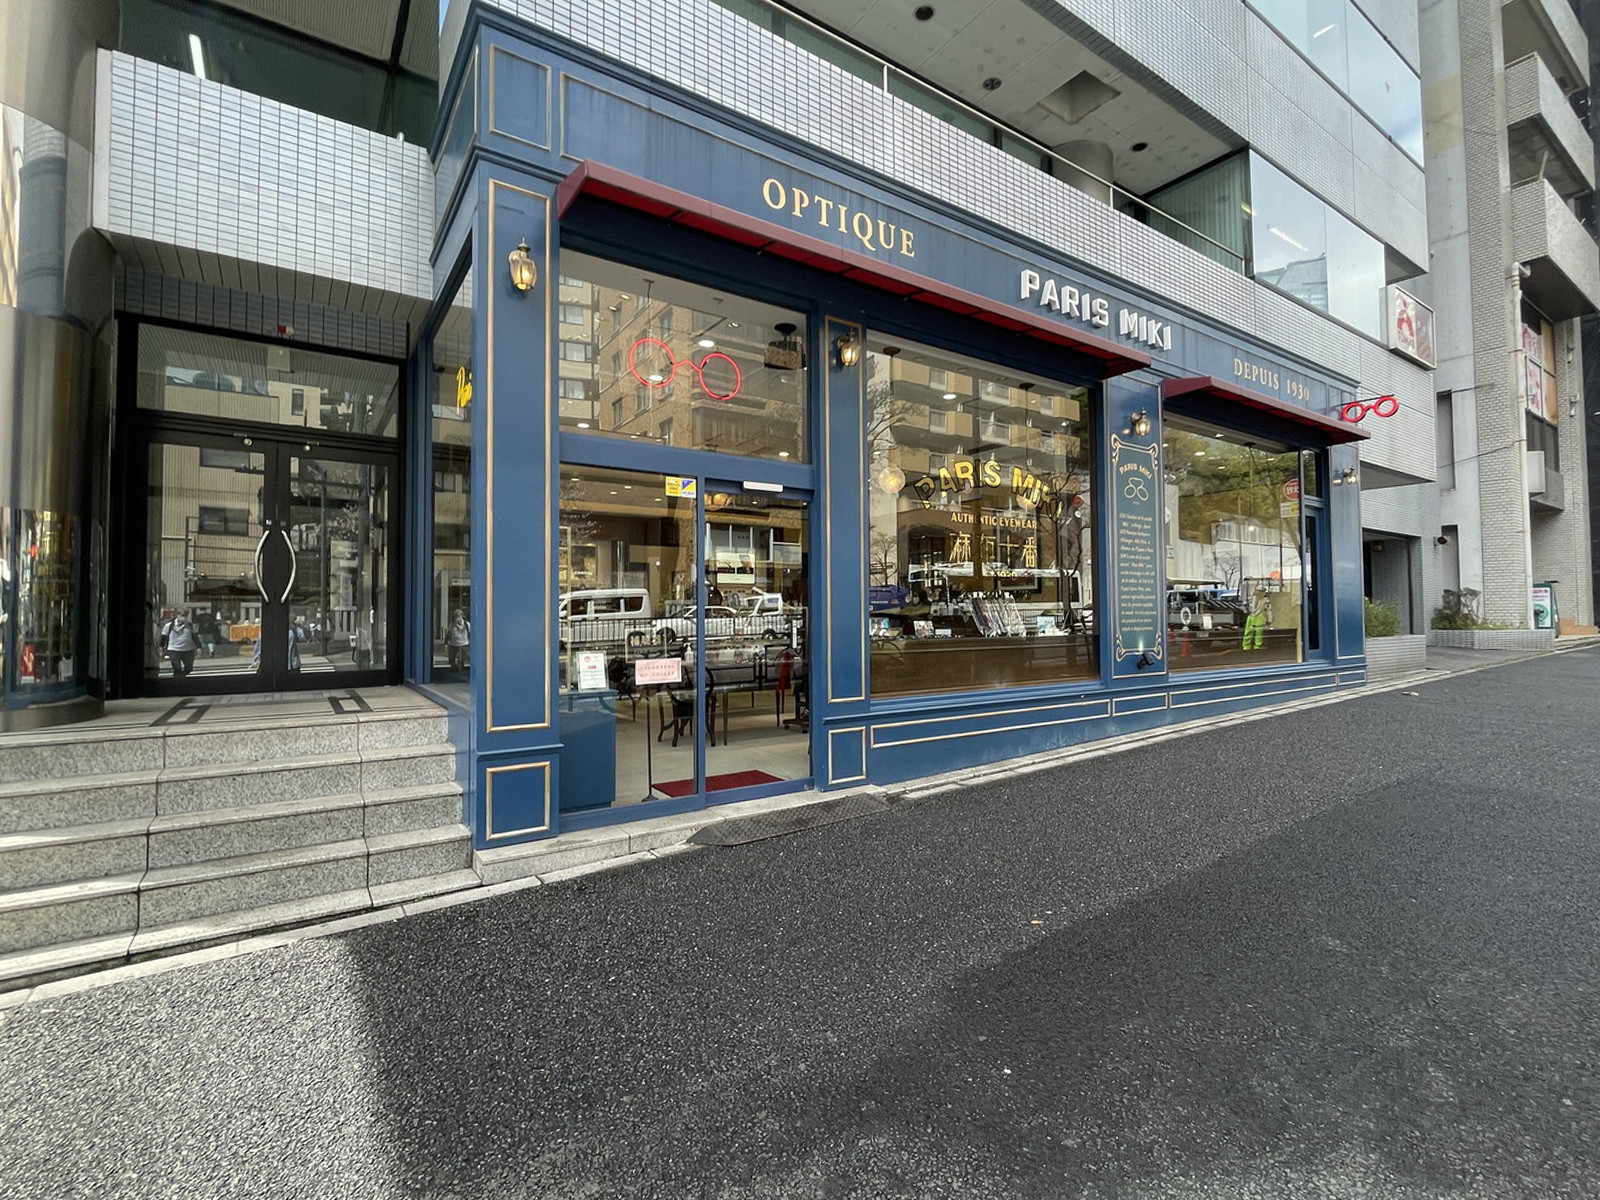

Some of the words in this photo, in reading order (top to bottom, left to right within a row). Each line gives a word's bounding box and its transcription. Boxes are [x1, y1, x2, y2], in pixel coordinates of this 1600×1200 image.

[762, 178, 916, 258] OPTIQUE
[1020, 269, 1110, 328] PARIS
[1118, 307, 1172, 351] MIKI
[1234, 358, 1279, 389] DEPUIS
[1286, 379, 1310, 402] 1930
[914, 459, 1001, 510] PARIS
[950, 512, 997, 526] AUTHNTIC
[999, 517, 1037, 530] EYEWEAR
